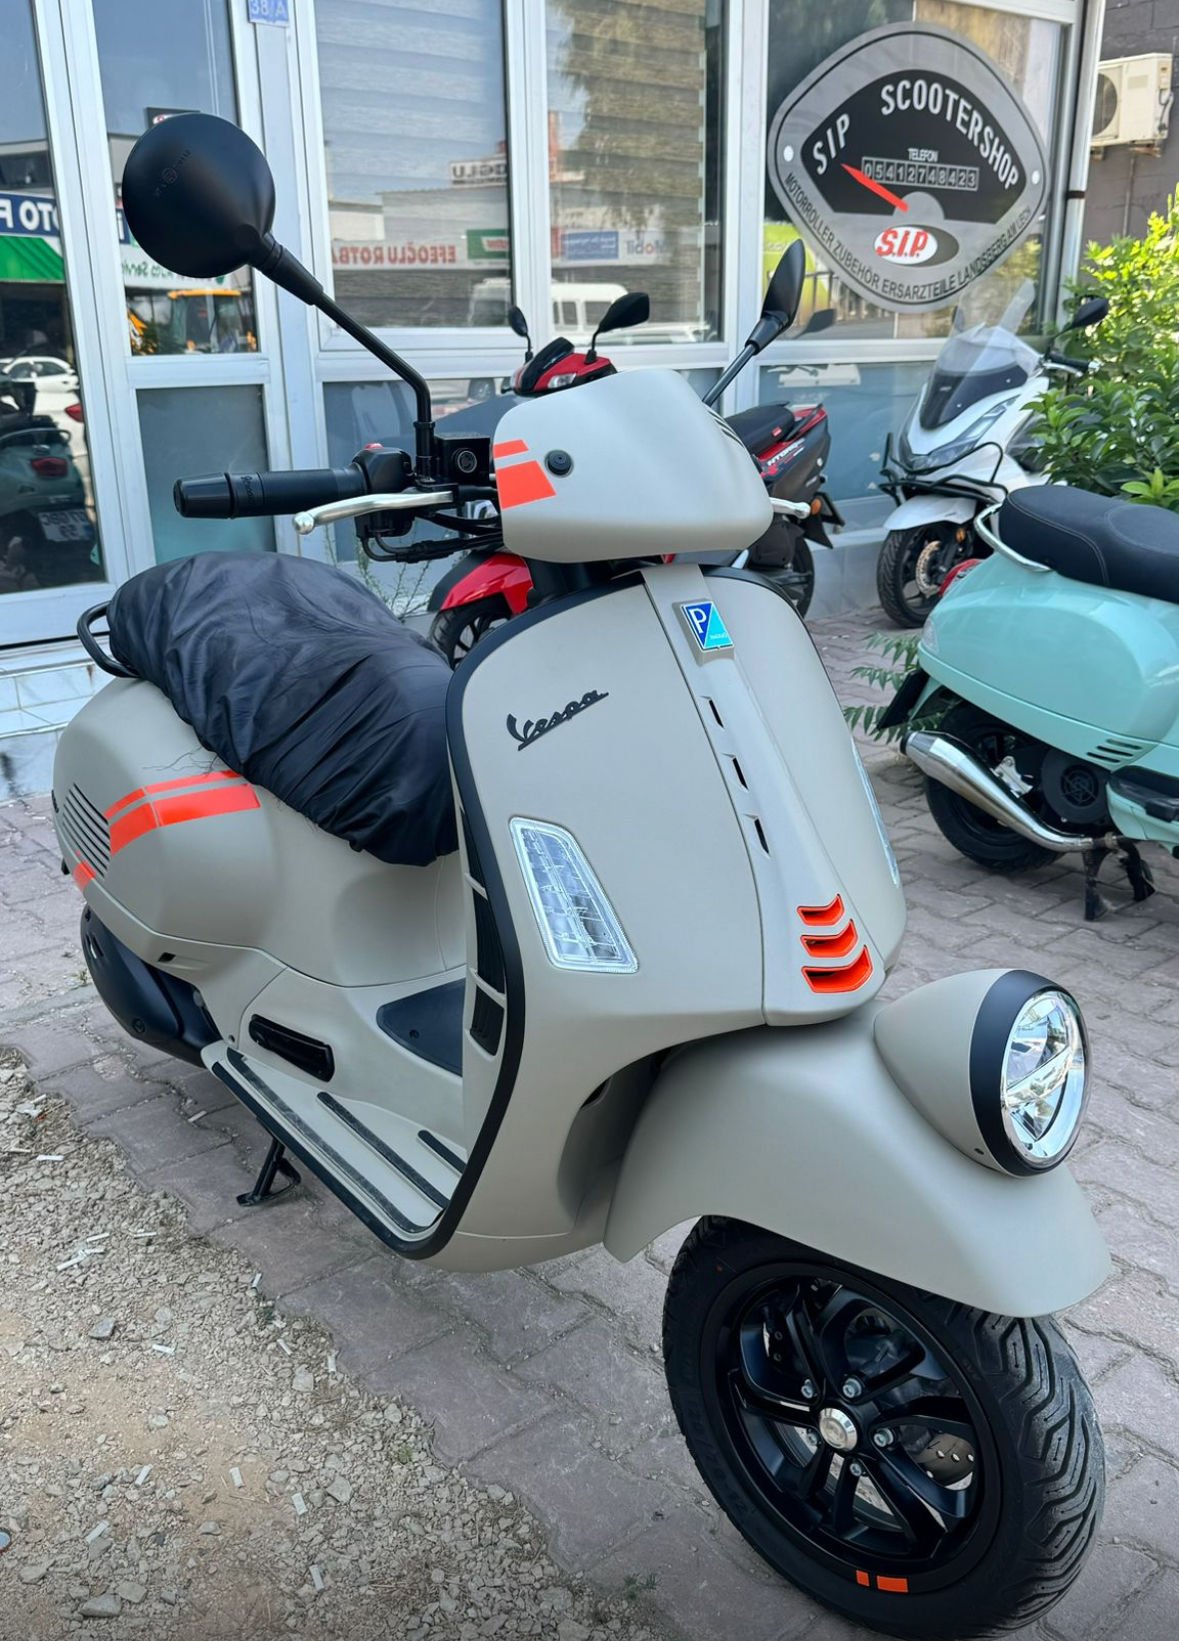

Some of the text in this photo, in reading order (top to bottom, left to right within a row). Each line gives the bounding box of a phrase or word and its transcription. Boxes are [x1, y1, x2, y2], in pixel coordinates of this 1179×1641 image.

[812, 79, 1019, 190] SIP SCOOTERSHOP
[907, 147, 939, 162] TELEFON
[864, 160, 977, 188] 05412748423
[784, 172, 835, 249] MOTORROLLER
[881, 273, 957, 300] ERSARZTEILE
[688, 607, 707, 634] P
[506, 690, 610, 752] Vespa
